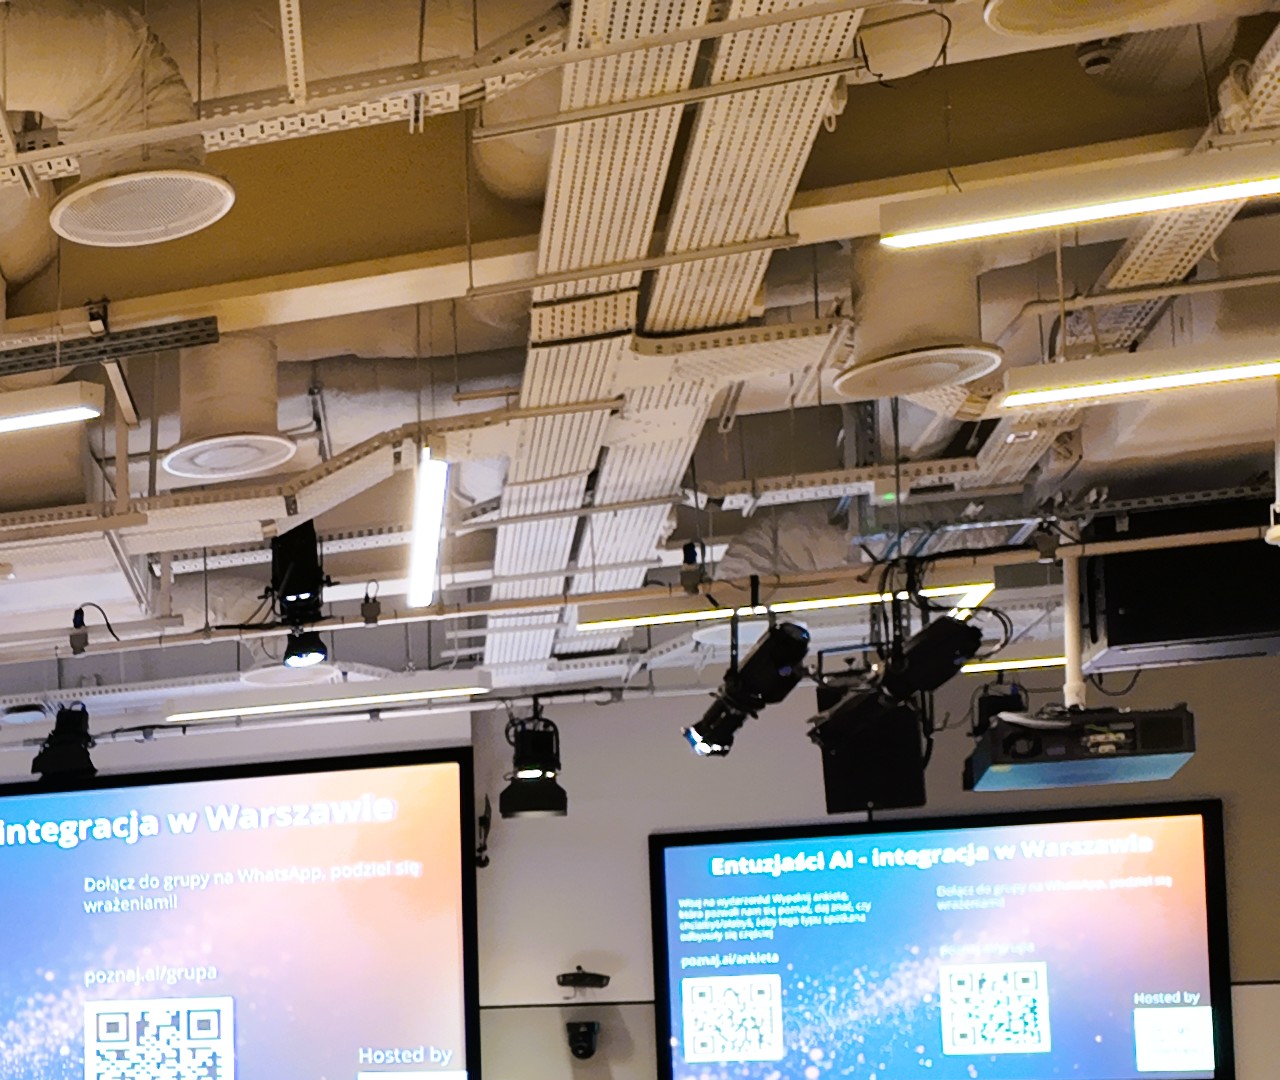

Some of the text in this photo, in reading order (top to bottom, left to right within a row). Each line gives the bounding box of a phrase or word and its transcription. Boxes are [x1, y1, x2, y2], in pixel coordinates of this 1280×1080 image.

[167, 812, 197, 834] w
[204, 794, 396, 832] Warszawie
[712, 851, 825, 877] Entuzjaści
[829, 850, 853, 870] AI
[872, 839, 990, 869] integracja
[995, 843, 1018, 861] w
[1022, 833, 1154, 860] Warszawie
[84, 861, 422, 894] Dołącz do grupy na WhatsApp, podziel się
[83, 895, 178, 913] wrażeniami!
[84, 964, 217, 987] poznaj.ai/grupa
[1134, 991, 1200, 1005] Hosted by
[359, 1046, 453, 1066] Hosted by
